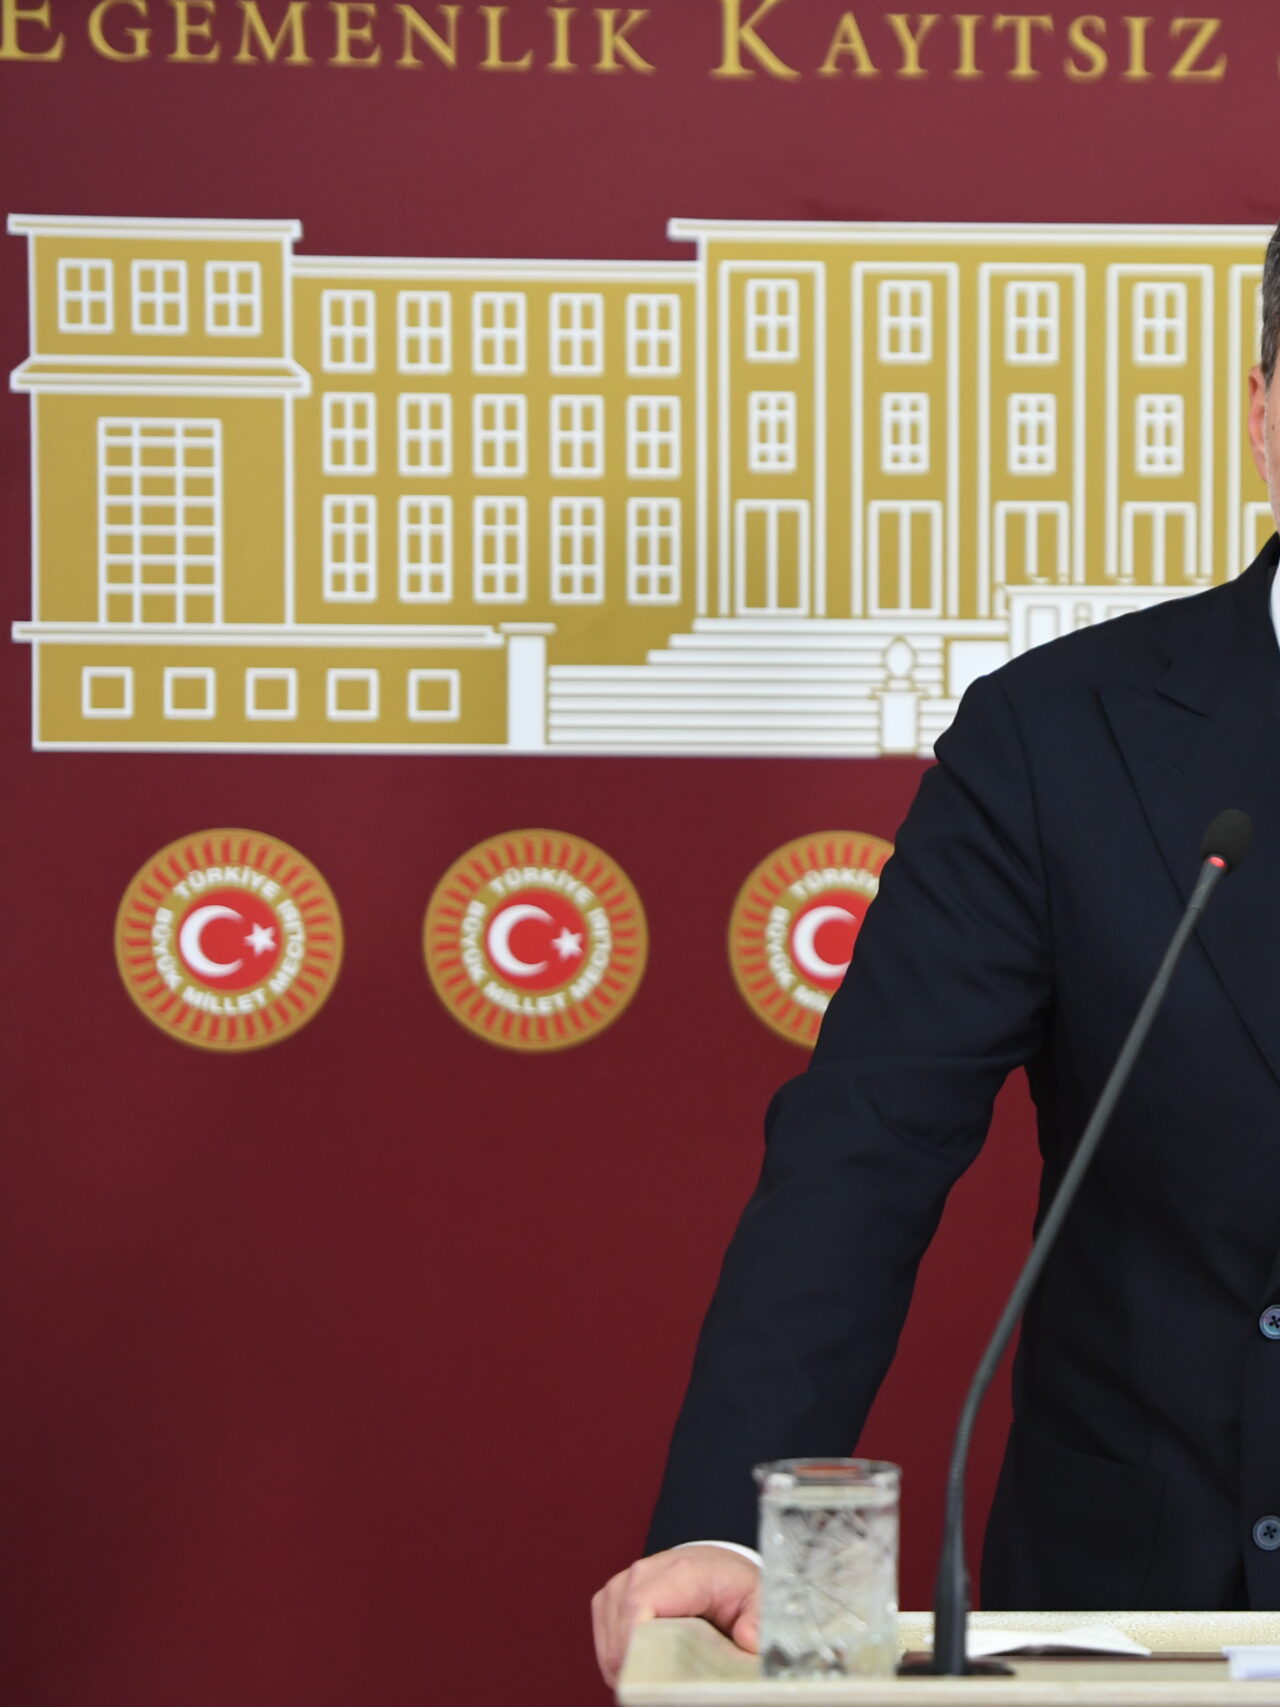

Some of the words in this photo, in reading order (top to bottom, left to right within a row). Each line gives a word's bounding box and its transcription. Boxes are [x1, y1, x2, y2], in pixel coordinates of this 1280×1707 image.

[0, 0, 657, 74] EGEMENLİK
[708, 0, 1227, 81] KAYITSIZ
[173, 866, 282, 901] TÜRKİYE
[152, 907, 184, 990] BÜYÜK
[181, 985, 268, 1016] MİLLET
[461, 900, 488, 983] BÜYÜK
